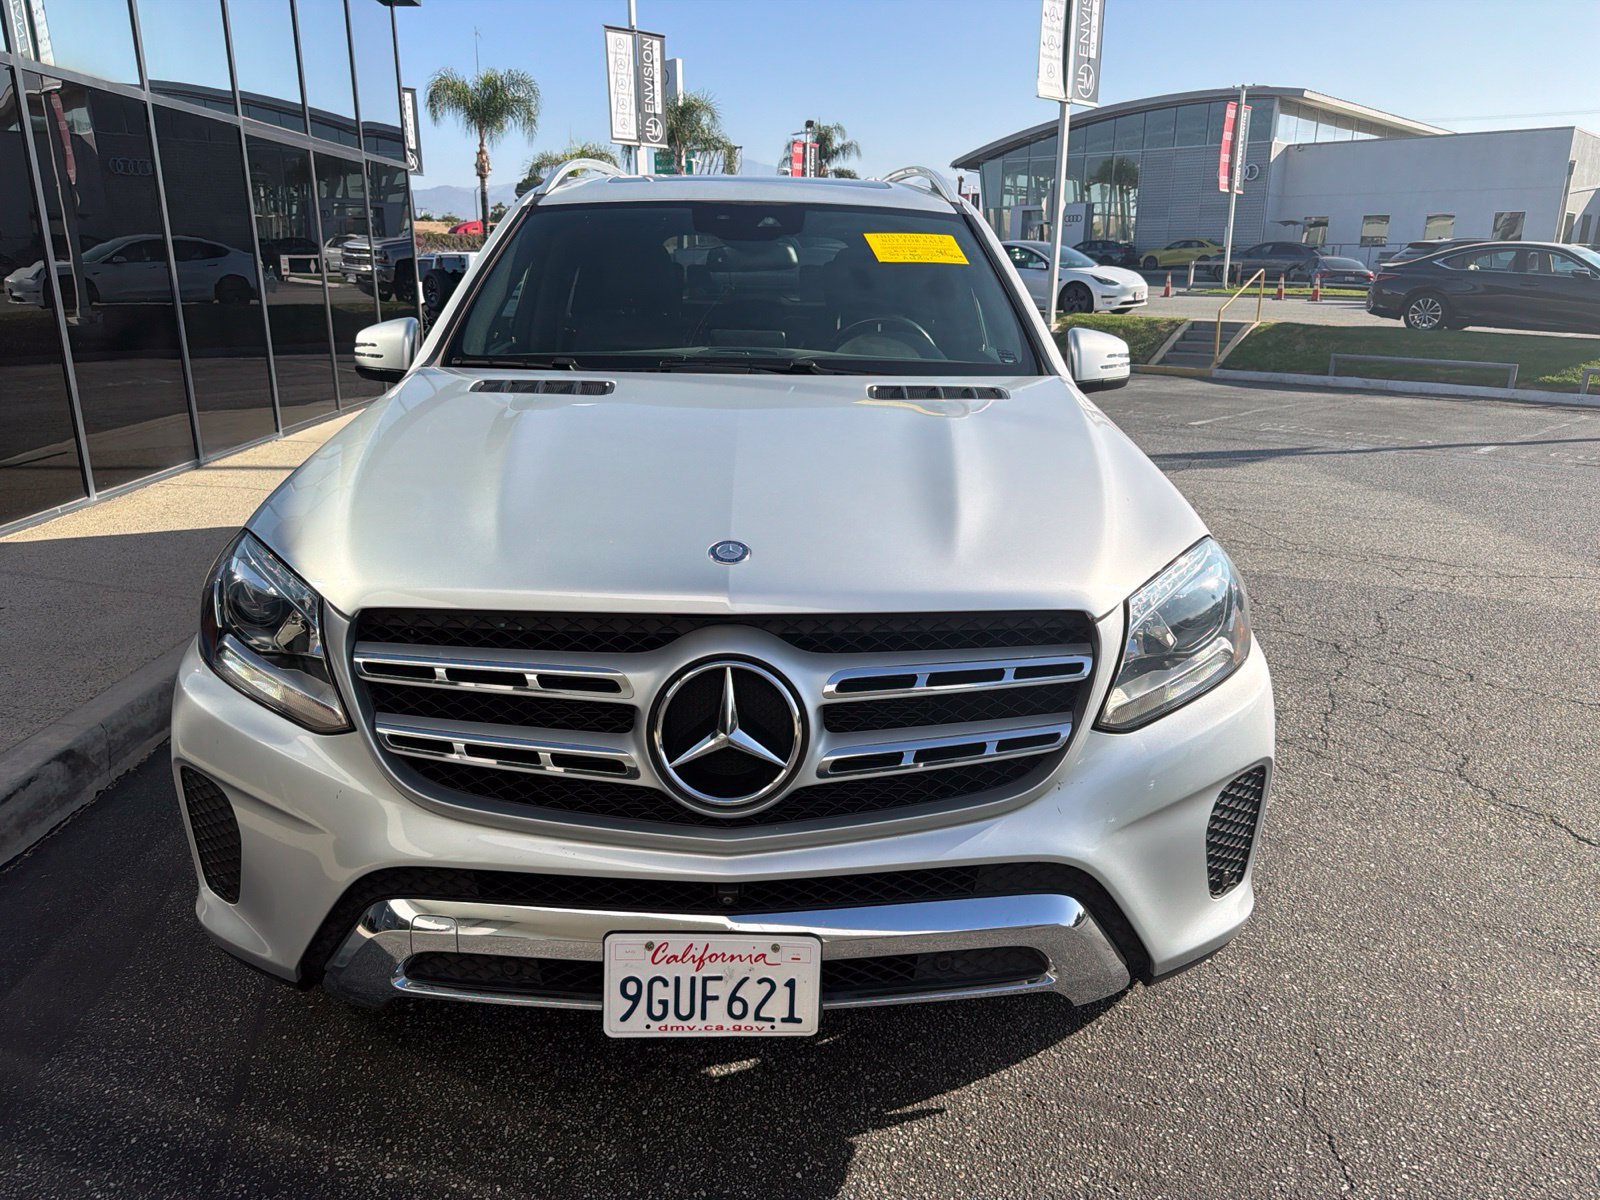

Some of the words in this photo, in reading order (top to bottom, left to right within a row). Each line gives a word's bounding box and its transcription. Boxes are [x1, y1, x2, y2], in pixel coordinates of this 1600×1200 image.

[642, 38, 655, 113] ENVISION
[651, 941, 781, 972] California
[619, 975, 803, 1024] 9GUF621
[658, 1023, 766, 1032] dmv.ca.gov
